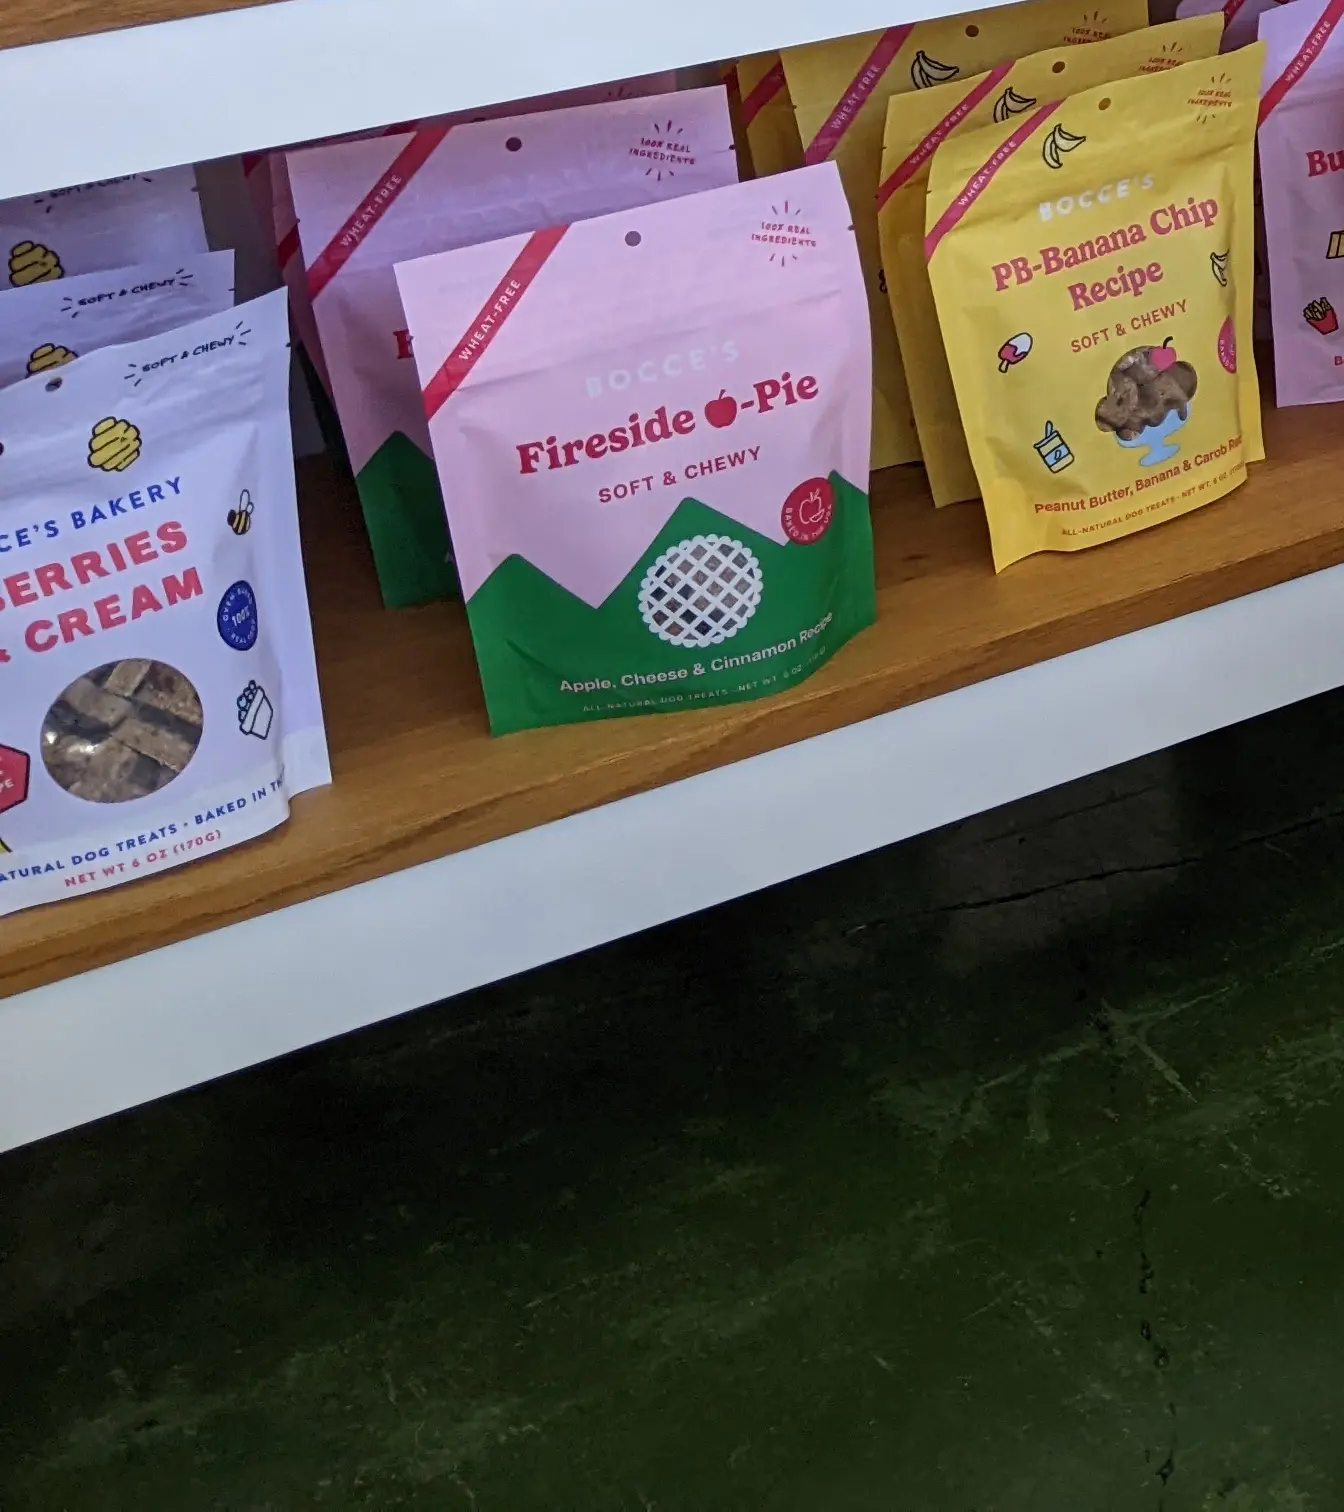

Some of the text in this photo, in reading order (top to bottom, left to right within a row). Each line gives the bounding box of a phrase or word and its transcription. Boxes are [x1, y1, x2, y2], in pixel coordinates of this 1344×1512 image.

[1037, 174, 1155, 223] BOCCE'S
[992, 196, 1218, 292] PB-Banana Chip
[1067, 259, 1163, 311] Recipe
[192, 335, 237, 356] CHEWY
[457, 278, 522, 362] WHEAT-FREE
[1070, 299, 1189, 354] SOFT & CHEWY
[585, 341, 740, 399] BOCCE'S
[516, 410, 697, 475] Fireside
[71, 476, 182, 530] BAKERY
[598, 446, 762, 504] SOFT & CHEWY
[1034, 446, 1227, 514] Peanut Butter, Banana Carob
[25, 567, 204, 653] CREAM
[624, 612, 834, 687] Cheese & Cinnamon Recipe
[71, 789, 267, 866] DOG TREATS BAKED IN
[64, 830, 223, 887] NET WT OZ (170G)
